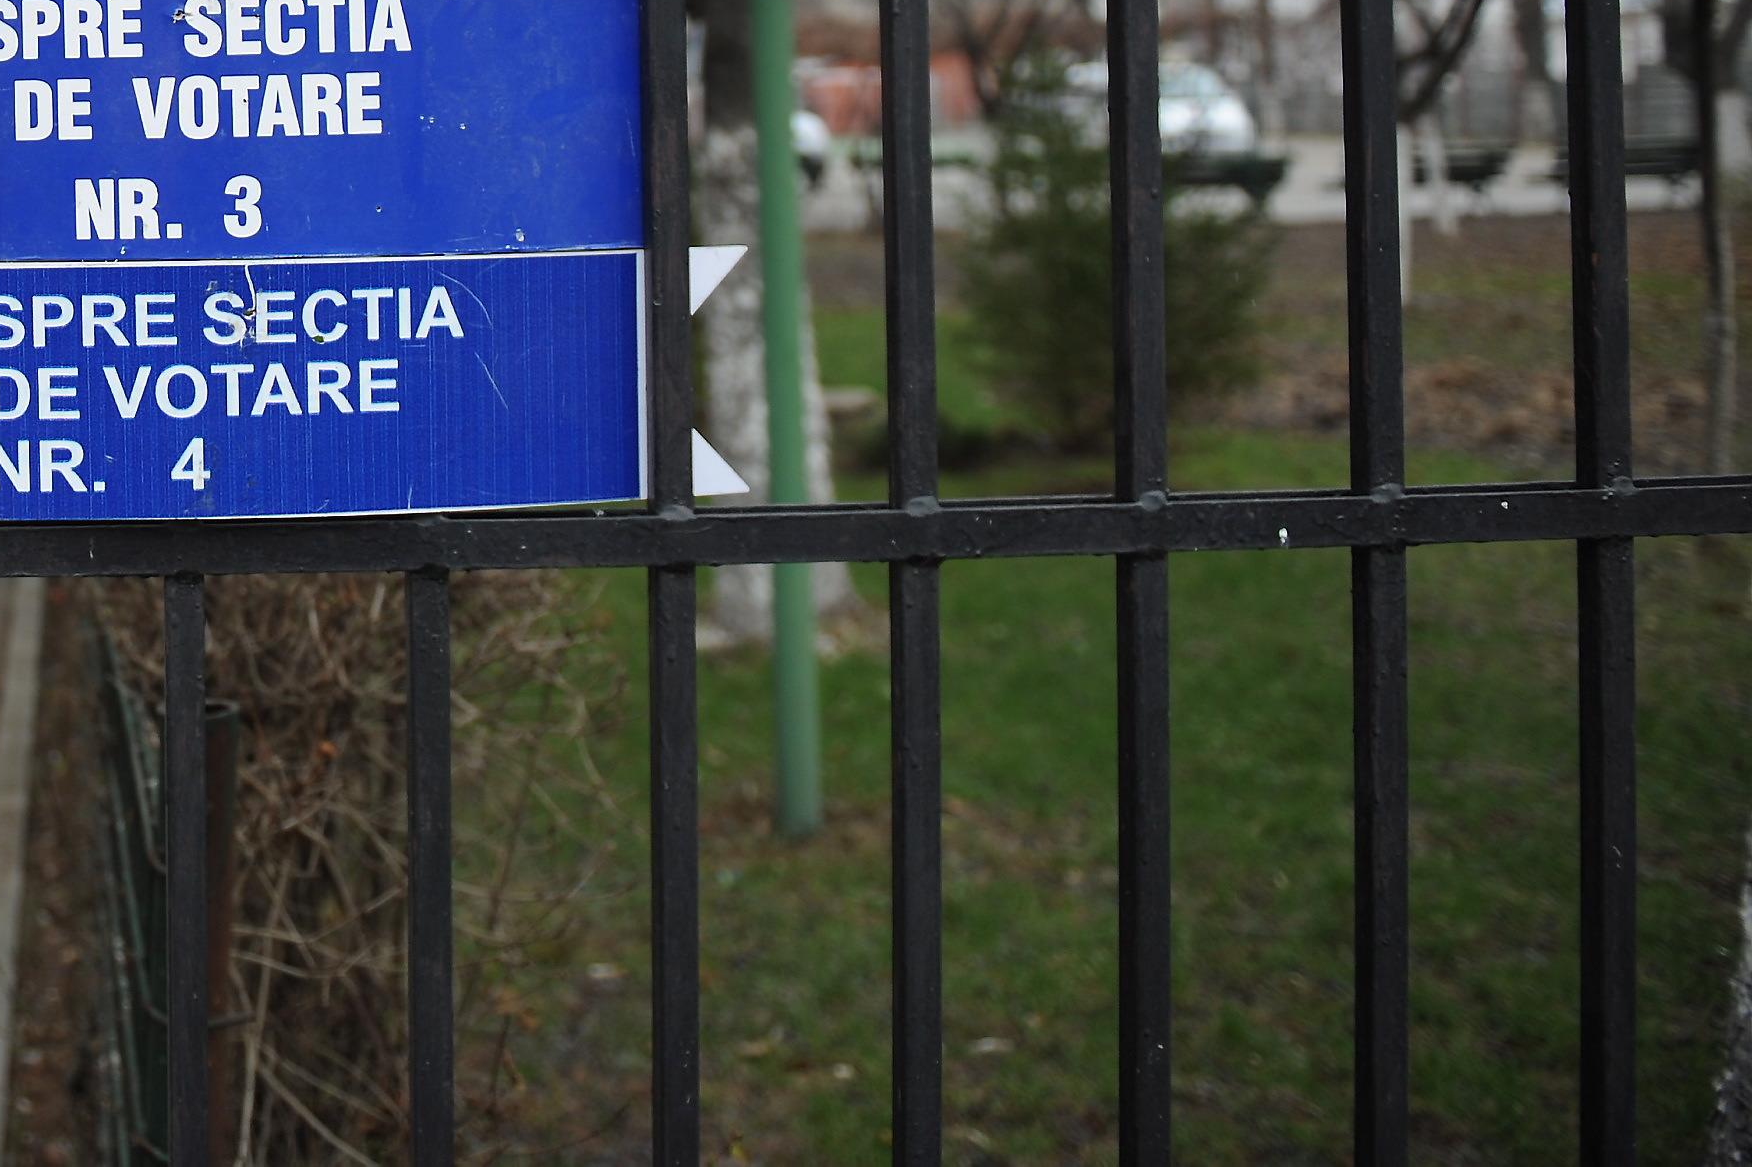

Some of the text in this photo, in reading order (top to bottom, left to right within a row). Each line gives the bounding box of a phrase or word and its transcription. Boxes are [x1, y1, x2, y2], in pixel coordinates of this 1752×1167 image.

[13, 71, 384, 141] DE VOTARE
[74, 174, 263, 240] NR. 3
[202, 285, 465, 348] SECTIA
[102, 359, 401, 419] VOTARE
[169, 437, 212, 491] 4
